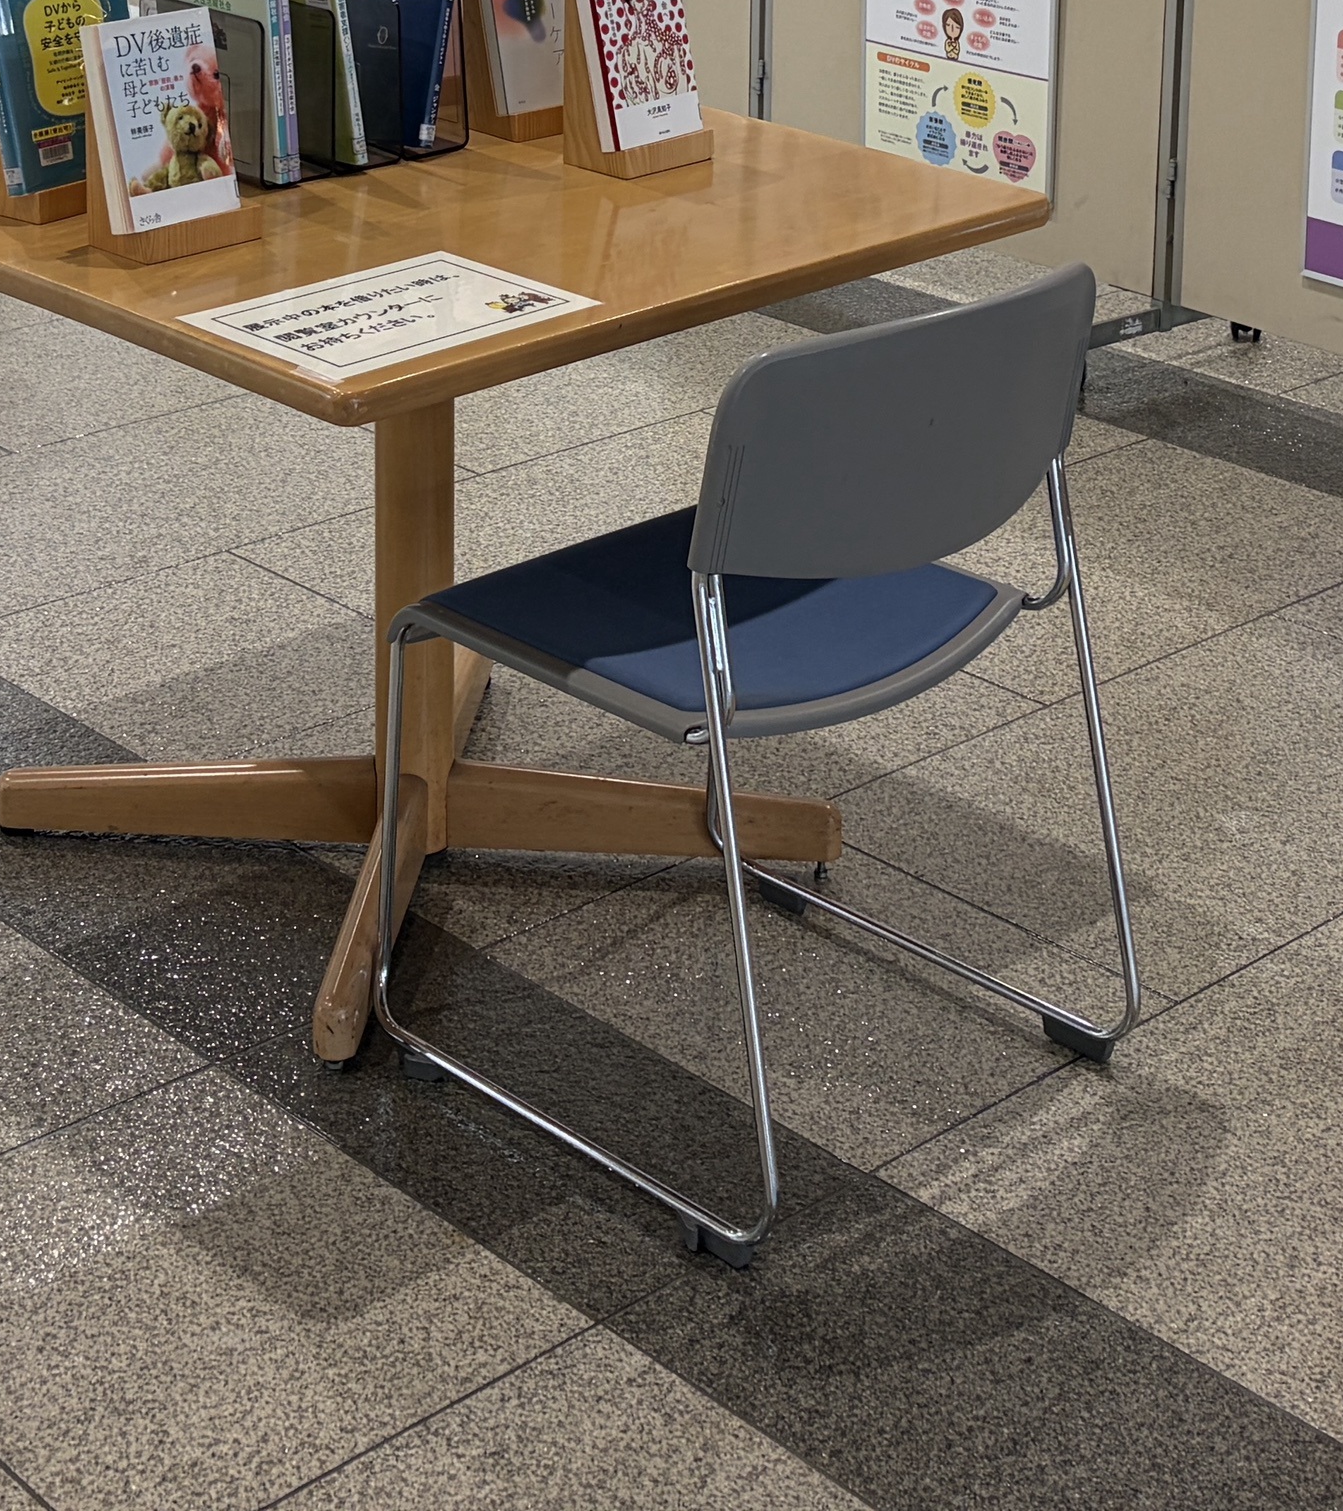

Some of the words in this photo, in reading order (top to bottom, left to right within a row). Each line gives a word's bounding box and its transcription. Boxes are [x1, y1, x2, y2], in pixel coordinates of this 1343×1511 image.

[43, 0, 82, 17] DVから
[44, 14, 86, 33] 子どもの
[113, 23, 203, 58] DV後遺症
[120, 56, 170, 78] に苦しむ
[123, 79, 149, 98] 母と
[126, 91, 190, 119] 子どもたち
[968, 149, 980, 159] ます
[241, 272, 460, 333] 展示中の本を借りたい時は、
[273, 293, 444, 344] 閲覧室カウンターに
